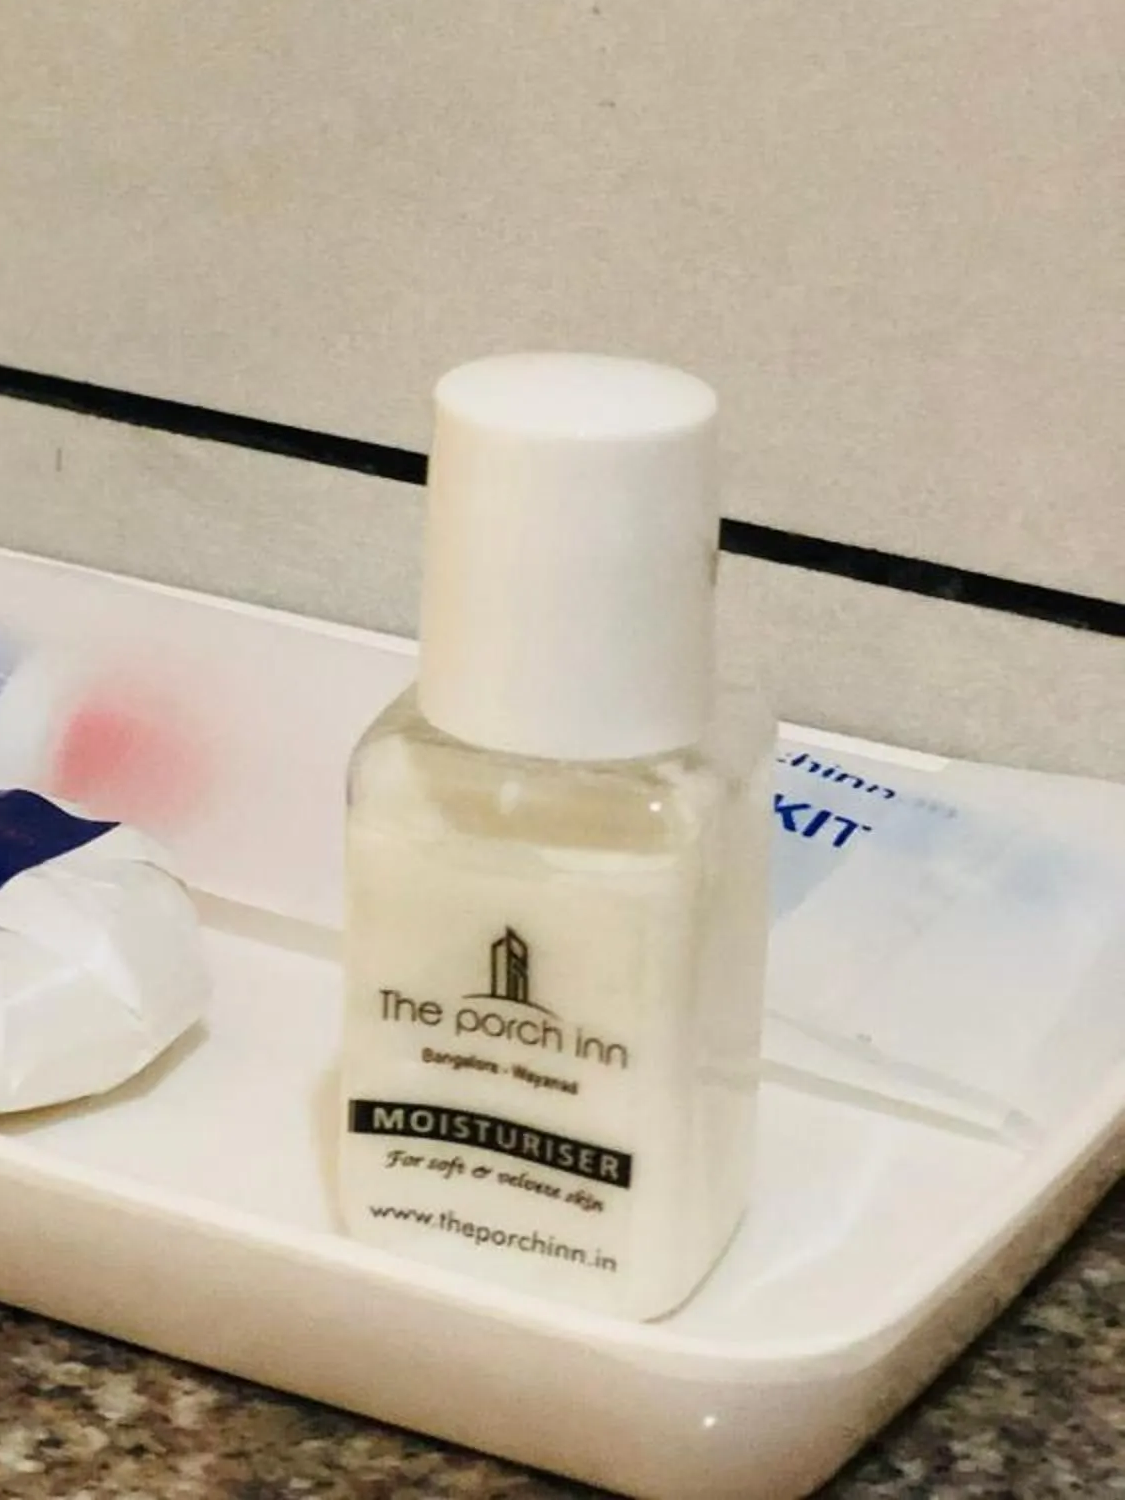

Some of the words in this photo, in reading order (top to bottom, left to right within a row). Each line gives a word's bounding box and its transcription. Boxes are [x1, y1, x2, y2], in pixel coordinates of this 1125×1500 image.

[773, 793, 873, 848] KIT
[379, 988, 443, 1027] The
[455, 1005, 564, 1053] porch
[575, 1026, 629, 1070] inn
[372, 1106, 621, 1182] MOISTURISER
[385, 1149, 423, 1170] For
[427, 1155, 466, 1180] soft
[369, 1203, 619, 1275] www.theporchinn.in
